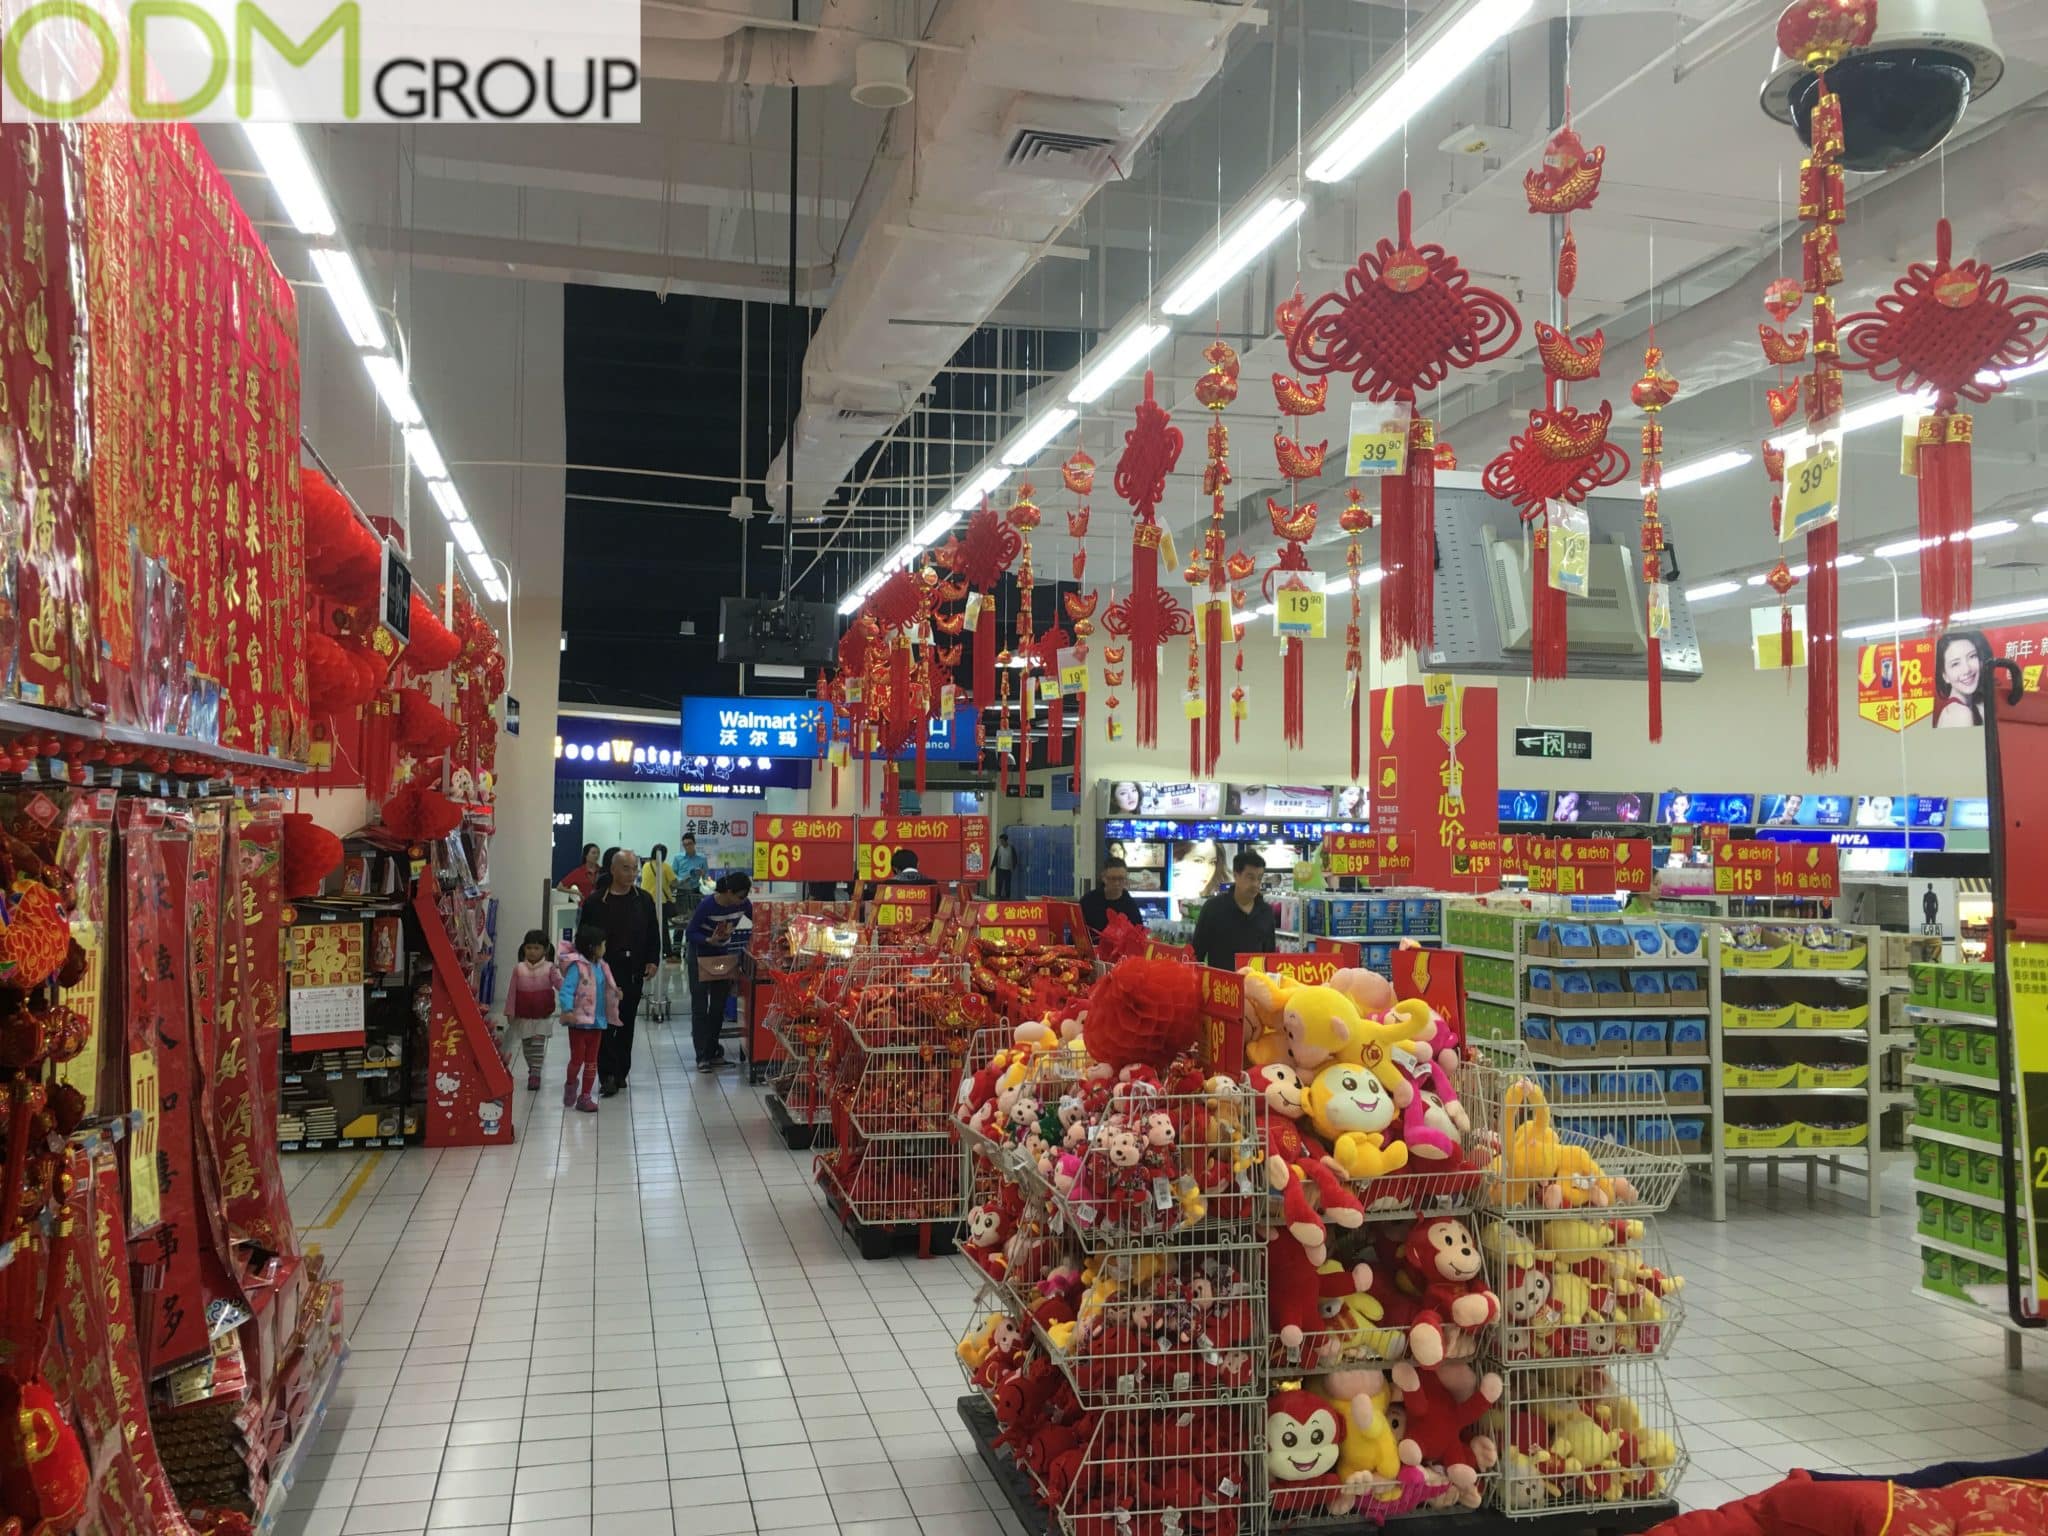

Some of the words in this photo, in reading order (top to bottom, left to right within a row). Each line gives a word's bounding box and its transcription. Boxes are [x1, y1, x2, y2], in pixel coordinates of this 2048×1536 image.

[719, 711, 797, 730] Walmart
[1876, 703, 1917, 721] 省心价
[719, 729, 798, 748] 沃尔玛
[792, 820, 842, 839] 省心价
[897, 820, 949, 839] 省心价
[1831, 834, 1870, 846] NIVEA
